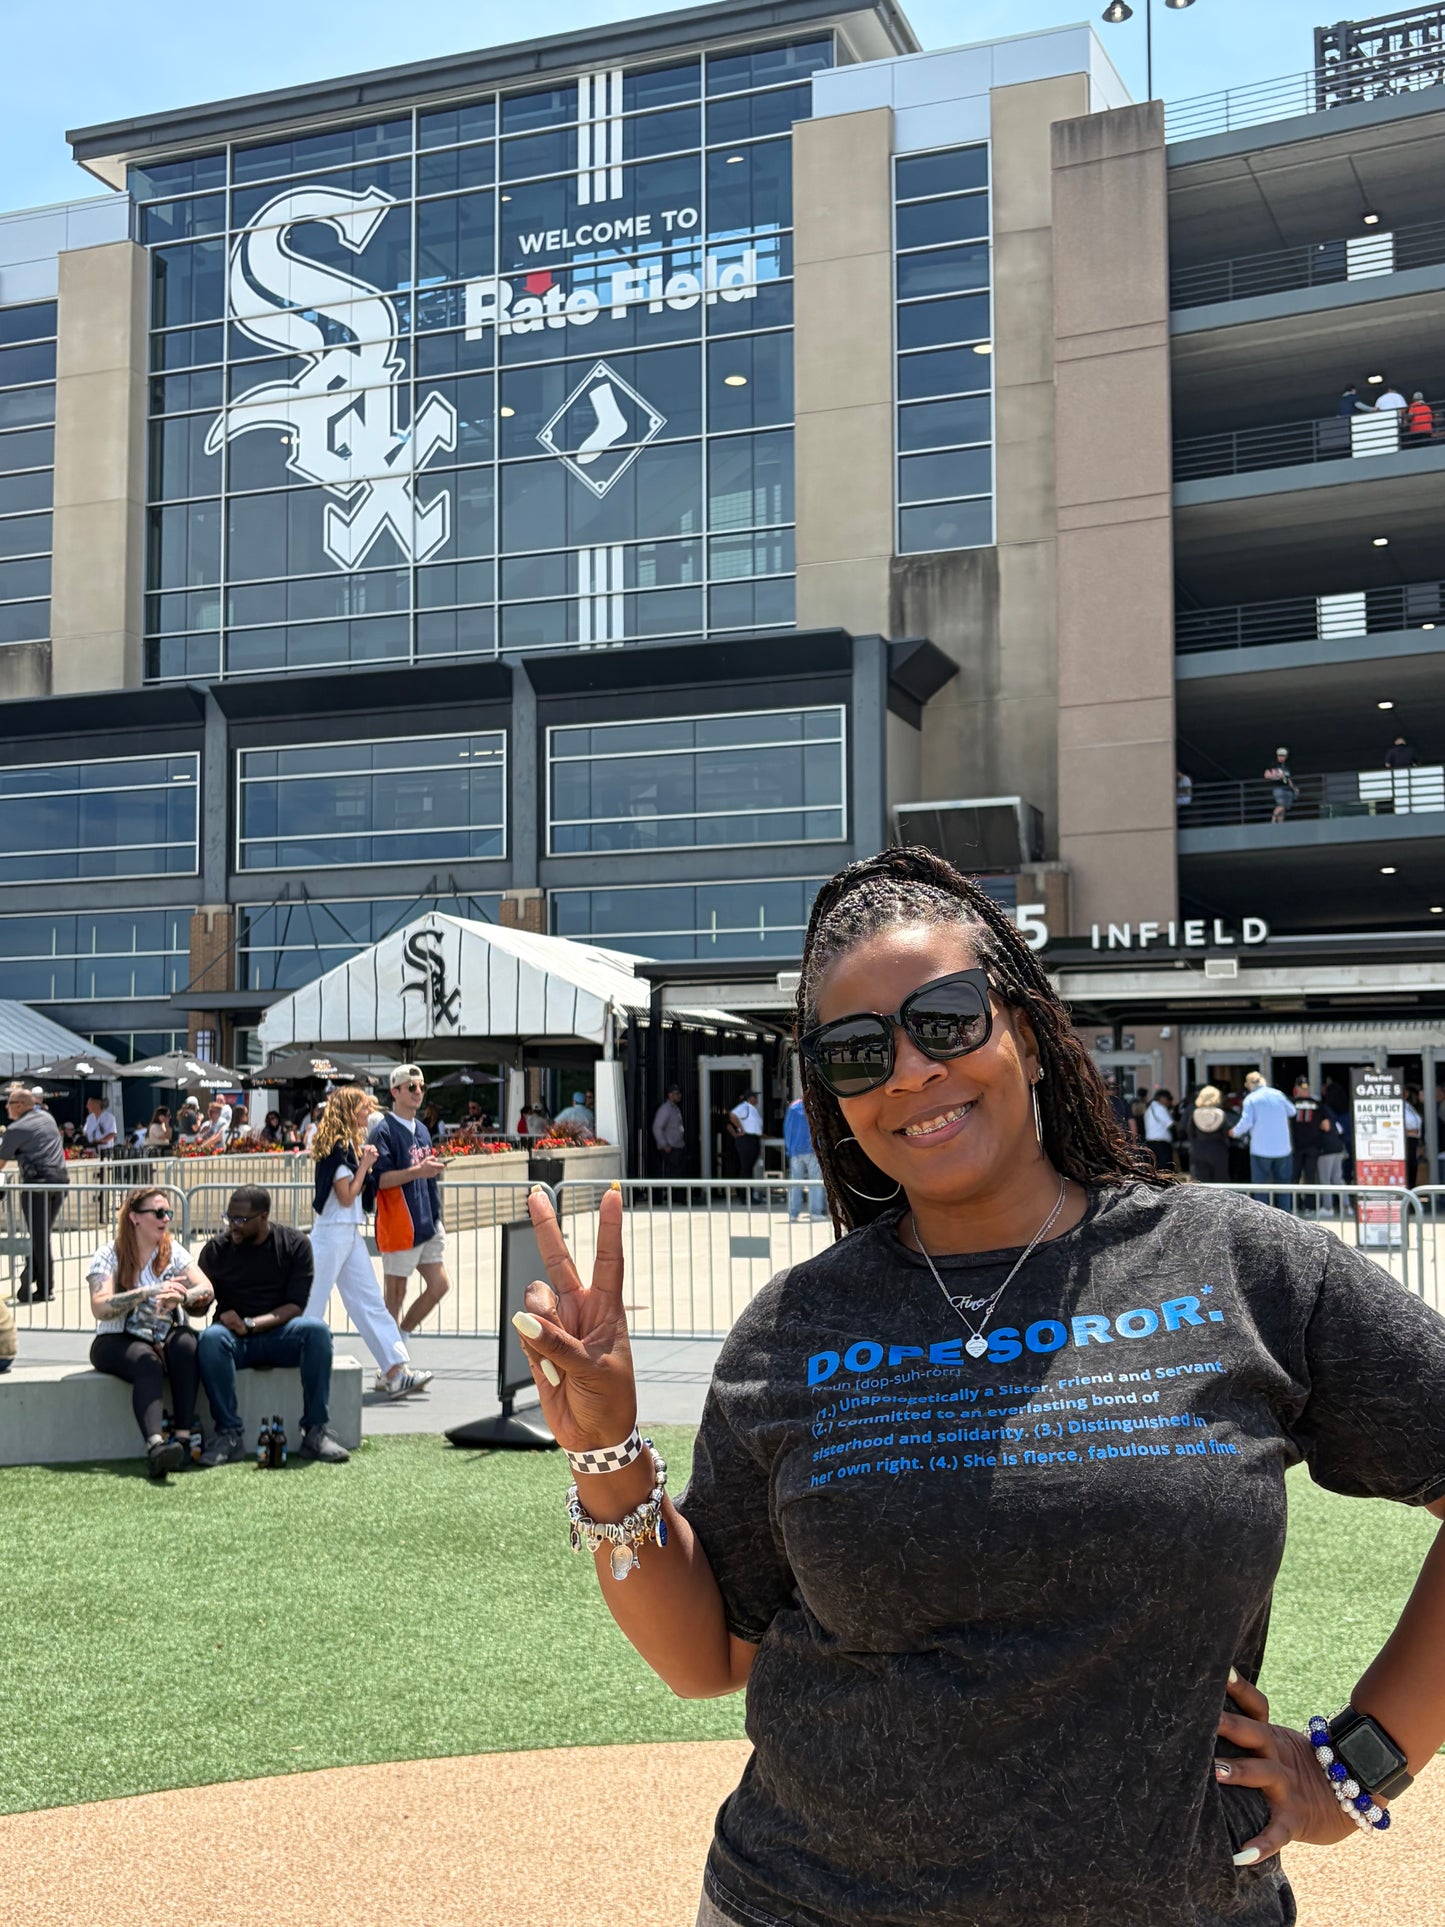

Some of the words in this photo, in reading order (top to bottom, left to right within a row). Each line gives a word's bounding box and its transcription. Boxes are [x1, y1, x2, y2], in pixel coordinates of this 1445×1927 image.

[518, 214, 652, 255] WELCOME
[661, 207, 698, 232] TO
[464, 279, 600, 342] Rate
[611, 249, 758, 320] Field
[1016, 904, 1049, 951] 5
[1091, 917, 1268, 949] INFIELD
[1356, 1084, 1391, 1096] GATE
[1357, 1104, 1373, 1113] BAG
[1375, 1104, 1401, 1113] POLICY
[807, 1338, 965, 1387] DOPE
[815, 1403, 837, 1422] (1.)
[840, 1388, 979, 1412] Unapologetically
[984, 1386, 994, 1397] a
[1058, 1372, 1114, 1391] Friend
[1118, 1370, 1151, 1382] and
[936, 1409, 955, 1419] to
[960, 1410, 982, 1419] an
[987, 1396, 1088, 1418] everlasting
[1092, 1392, 1137, 1406] bond
[1142, 1391, 1160, 1404] of
[812, 1433, 894, 1462] sisterhood
[899, 1431, 932, 1445] and
[937, 1426, 1030, 1444] solidarity.
[1034, 1422, 1063, 1439] (3.)
[1068, 1412, 1190, 1434] Distinguished
[1193, 1413, 1207, 1428] in
[810, 1470, 833, 1488] her
[837, 1461, 871, 1479] own
[876, 1457, 924, 1474] right.
[929, 1455, 958, 1471] (4.)
[963, 1453, 997, 1467] She
[1002, 1451, 1018, 1466] is
[1024, 1449, 1083, 1465] fierce,
[1088, 1442, 1171, 1460] fabulous
[1175, 1440, 1207, 1455] and
[1209, 1438, 1241, 1454] fine.
